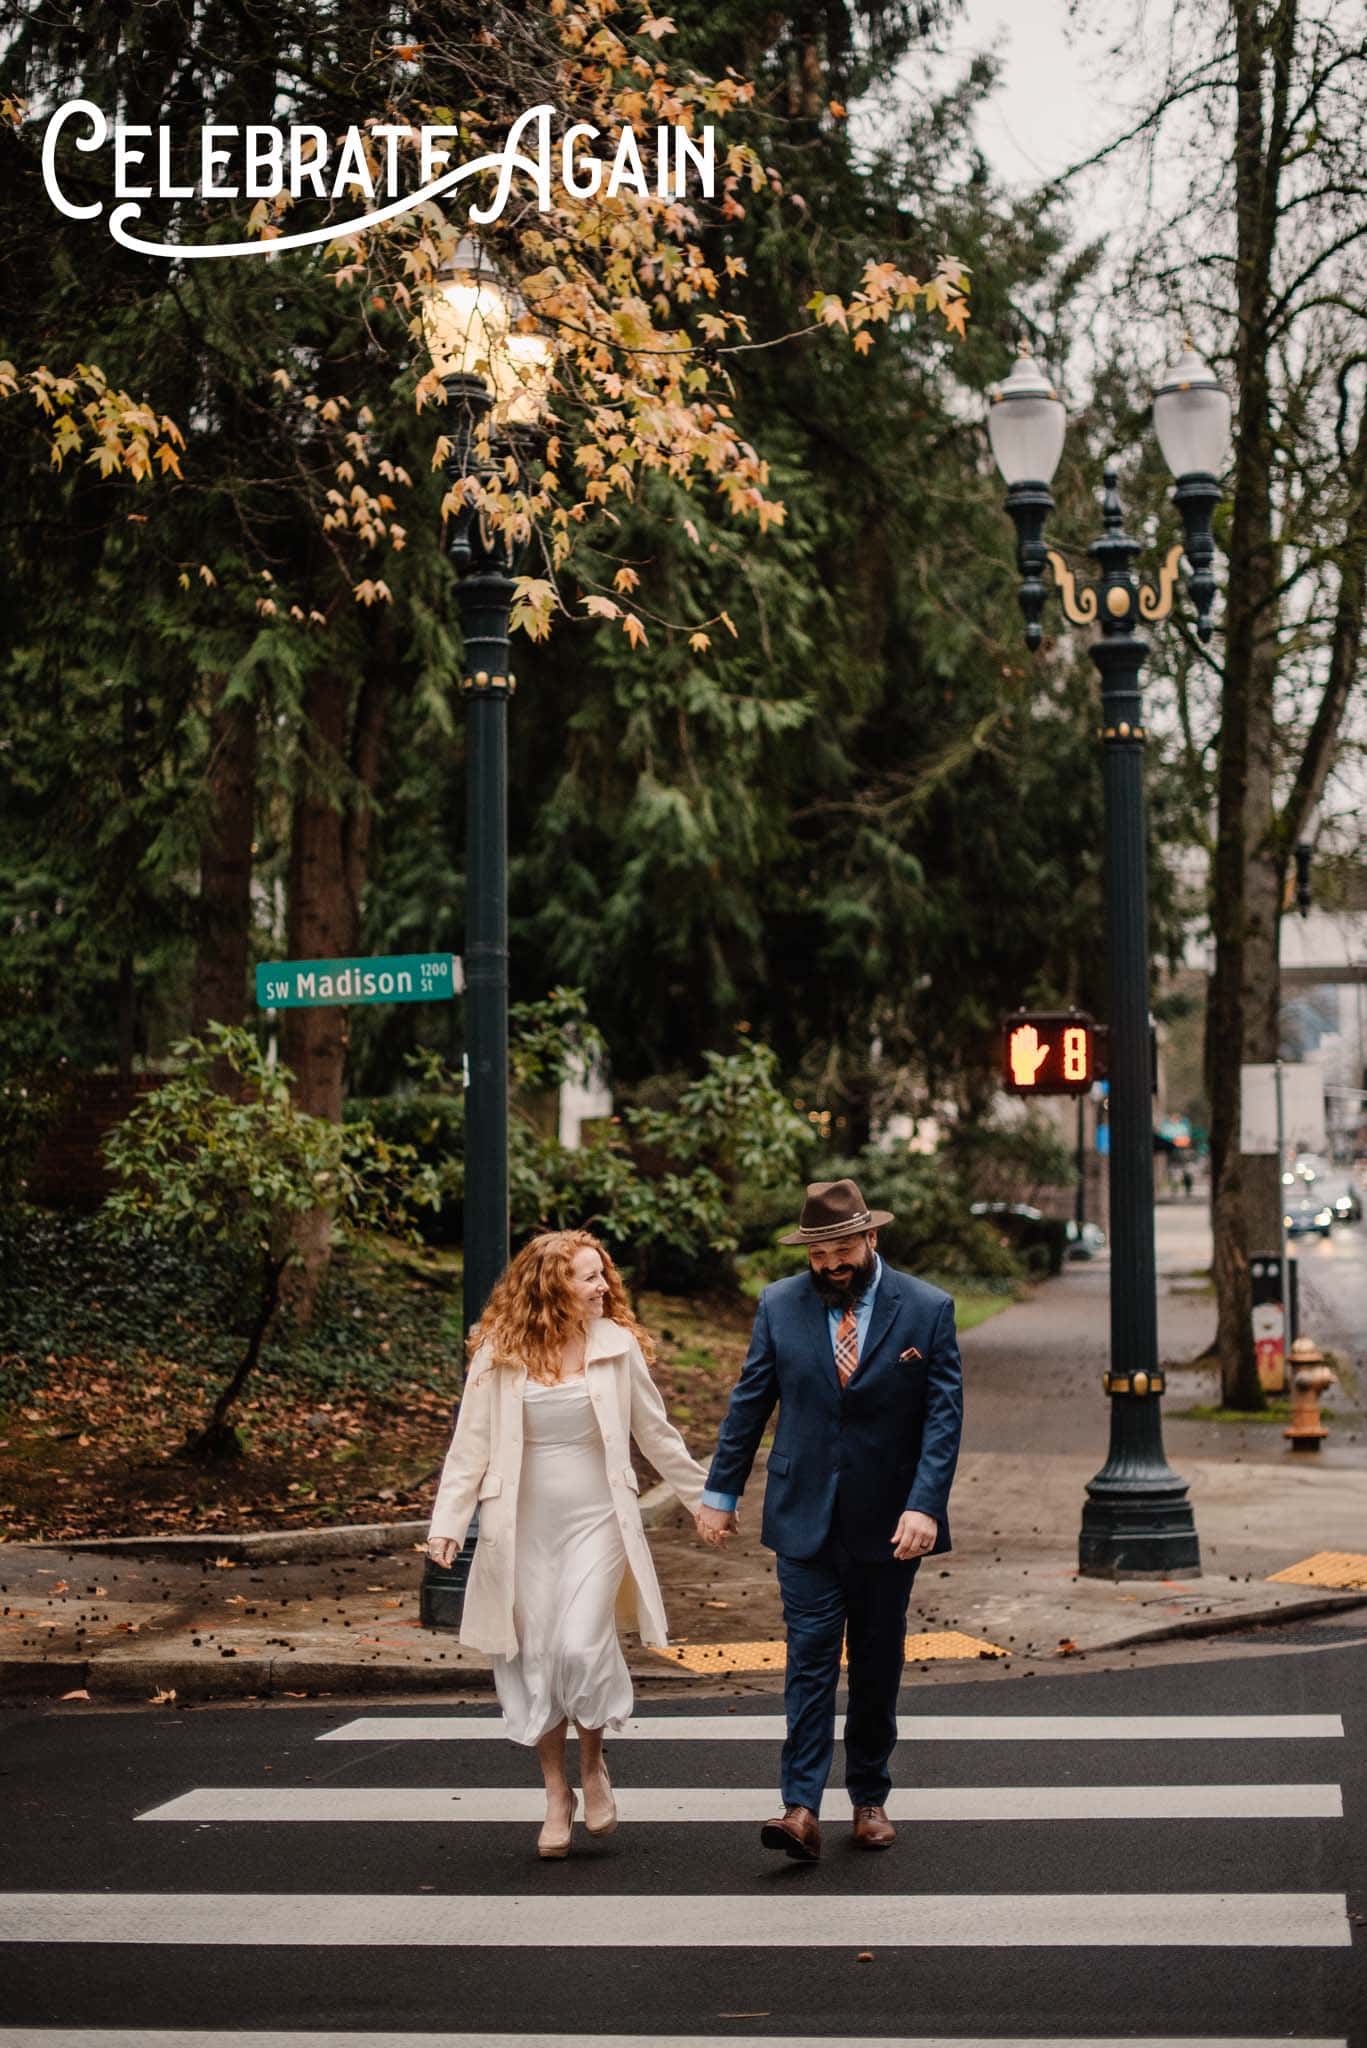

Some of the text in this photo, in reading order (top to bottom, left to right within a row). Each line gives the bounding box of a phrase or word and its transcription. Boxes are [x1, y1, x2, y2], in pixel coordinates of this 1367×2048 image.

[420, 962, 448, 977] 1200
[266, 968, 412, 1000] SW Madison
[420, 978, 433, 992] St
[1064, 1028, 1087, 1080] 8
